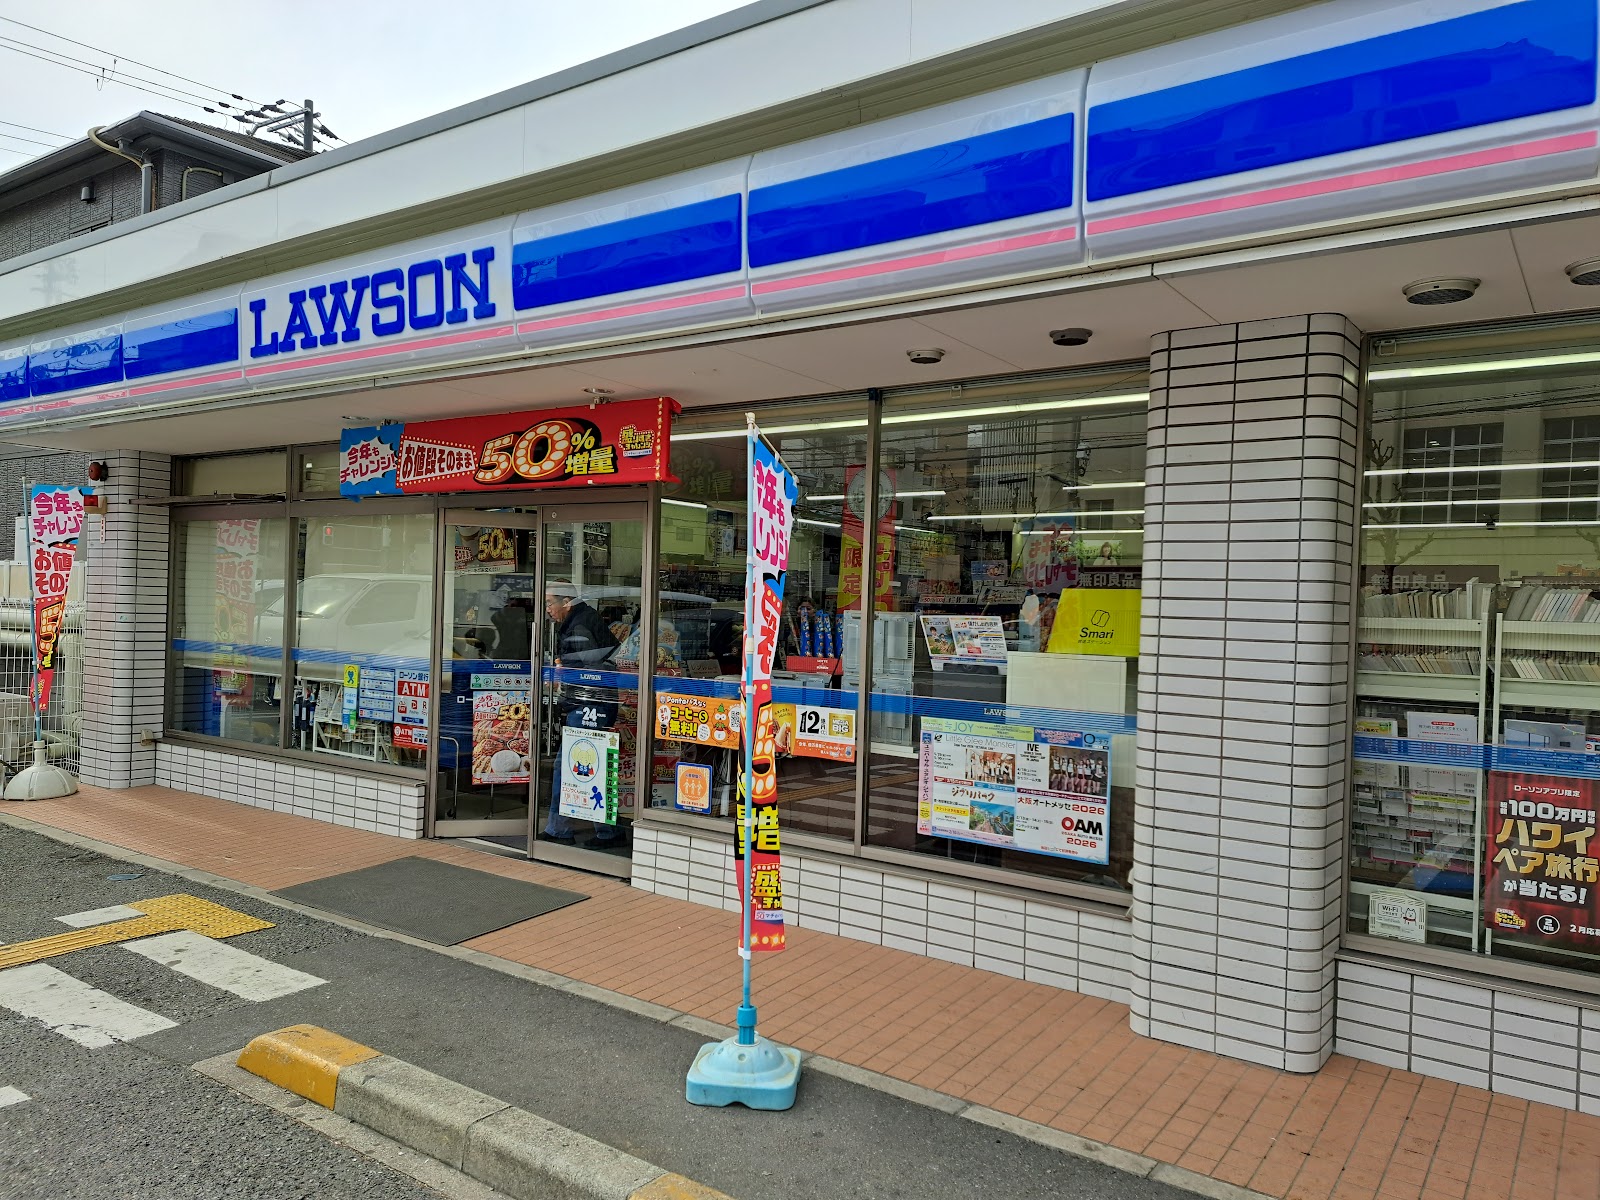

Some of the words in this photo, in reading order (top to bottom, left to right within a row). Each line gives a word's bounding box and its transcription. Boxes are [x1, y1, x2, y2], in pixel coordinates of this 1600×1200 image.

[250, 246, 496, 358] LAWSON
[347, 444, 380, 465] 今年も
[401, 445, 473, 479] お値段そのまま
[565, 446, 615, 476] 増量
[340, 454, 395, 483] チャレンジ!
[843, 547, 863, 595] 限定
[1078, 571, 1136, 588] 無印良品
[1079, 627, 1114, 640] Smari
[399, 671, 429, 682] ローソン銀行
[401, 682, 426, 697] ATM
[582, 706, 598, 722] 24
[799, 711, 820, 735] 12
[669, 718, 698, 737] 無料!
[832, 724, 849, 733] BIG
[945, 734, 963, 743] Little
[964, 735, 982, 745] Glee
[984, 739, 1016, 749] Monster
[1026, 743, 1040, 752] IVE
[951, 786, 995, 802] ジブリパーク
[1513, 784, 1582, 798] ローソンアプリ限定
[1508, 800, 1587, 824] 100万円
[1061, 816, 1104, 836] OAM
[1066, 837, 1097, 849] 2026
[1495, 818, 1596, 855] ハワイ
[1492, 847, 1600, 883] ペア旅行
[1503, 879, 1588, 905] が当たる!
[1382, 904, 1399, 913] Wi-Fi
